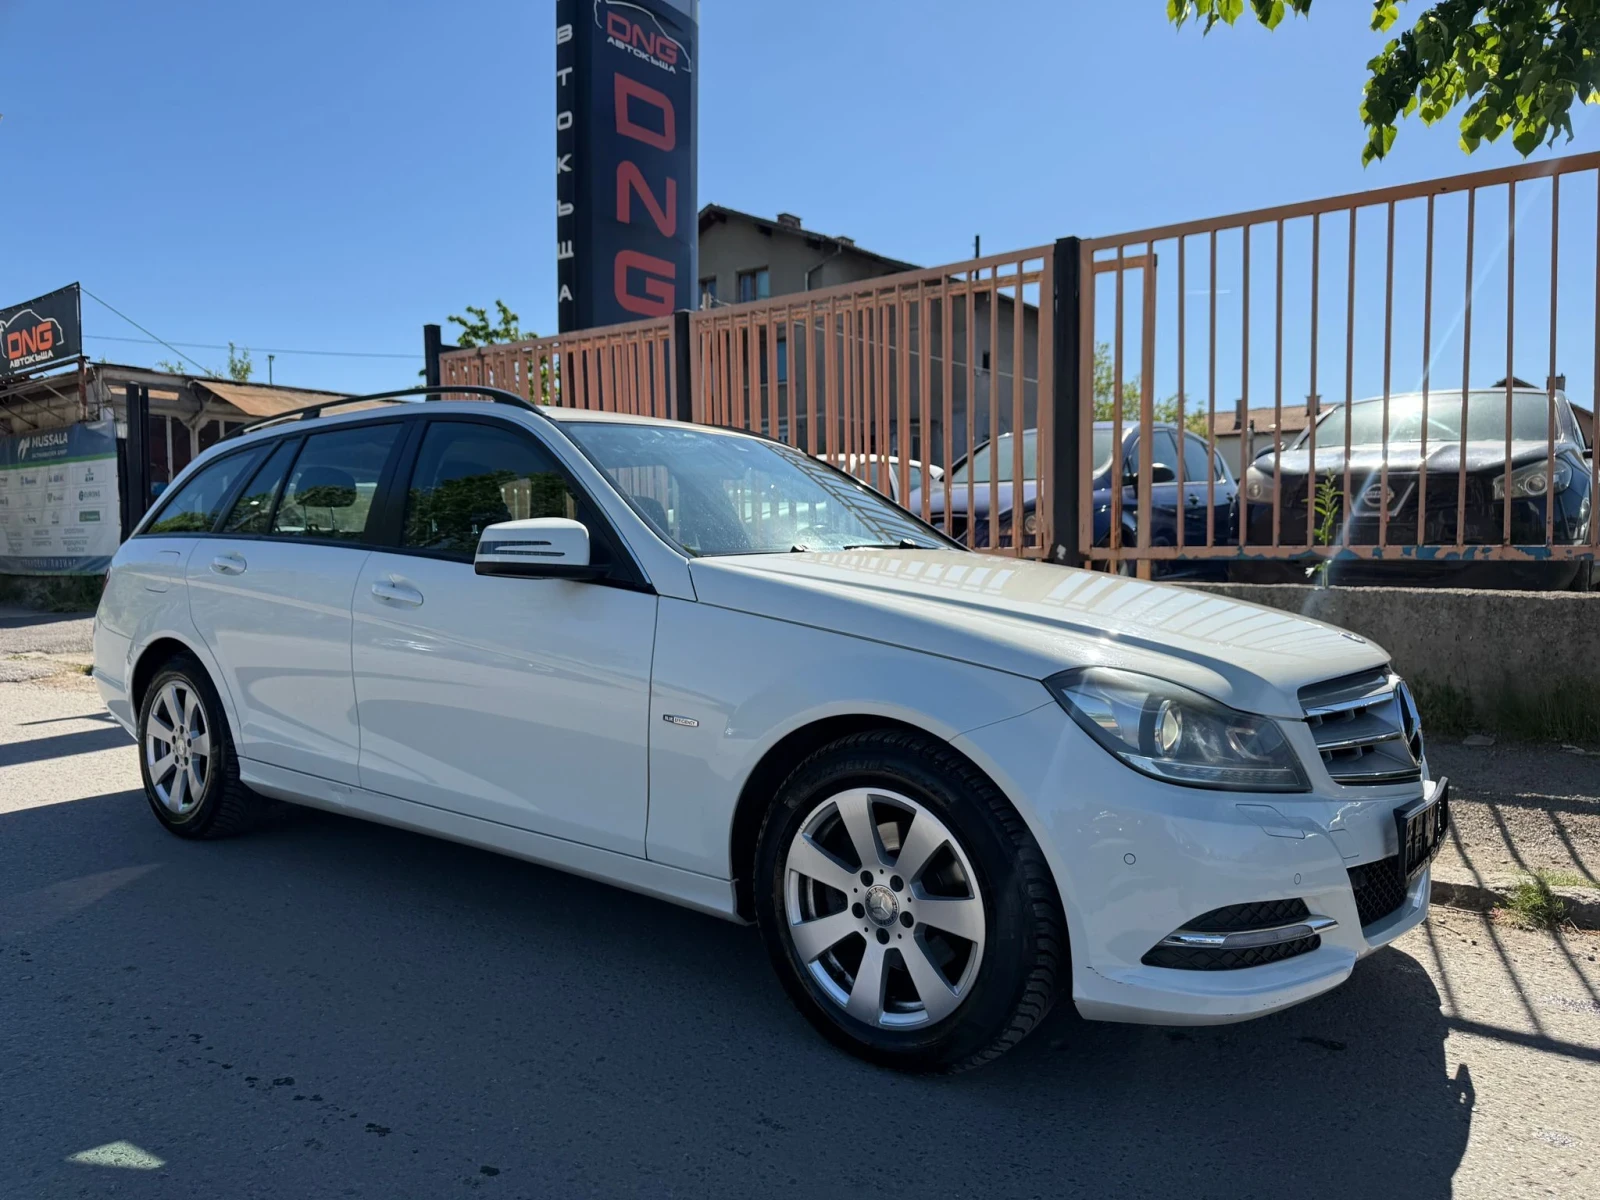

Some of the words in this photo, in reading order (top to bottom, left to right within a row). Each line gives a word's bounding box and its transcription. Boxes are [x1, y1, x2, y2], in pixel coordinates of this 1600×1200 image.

[606, 10, 678, 66] DNG
[613, 71, 677, 318] DNG
[7, 321, 53, 360] DNG
[31, 432, 68, 448] MUSSALA
